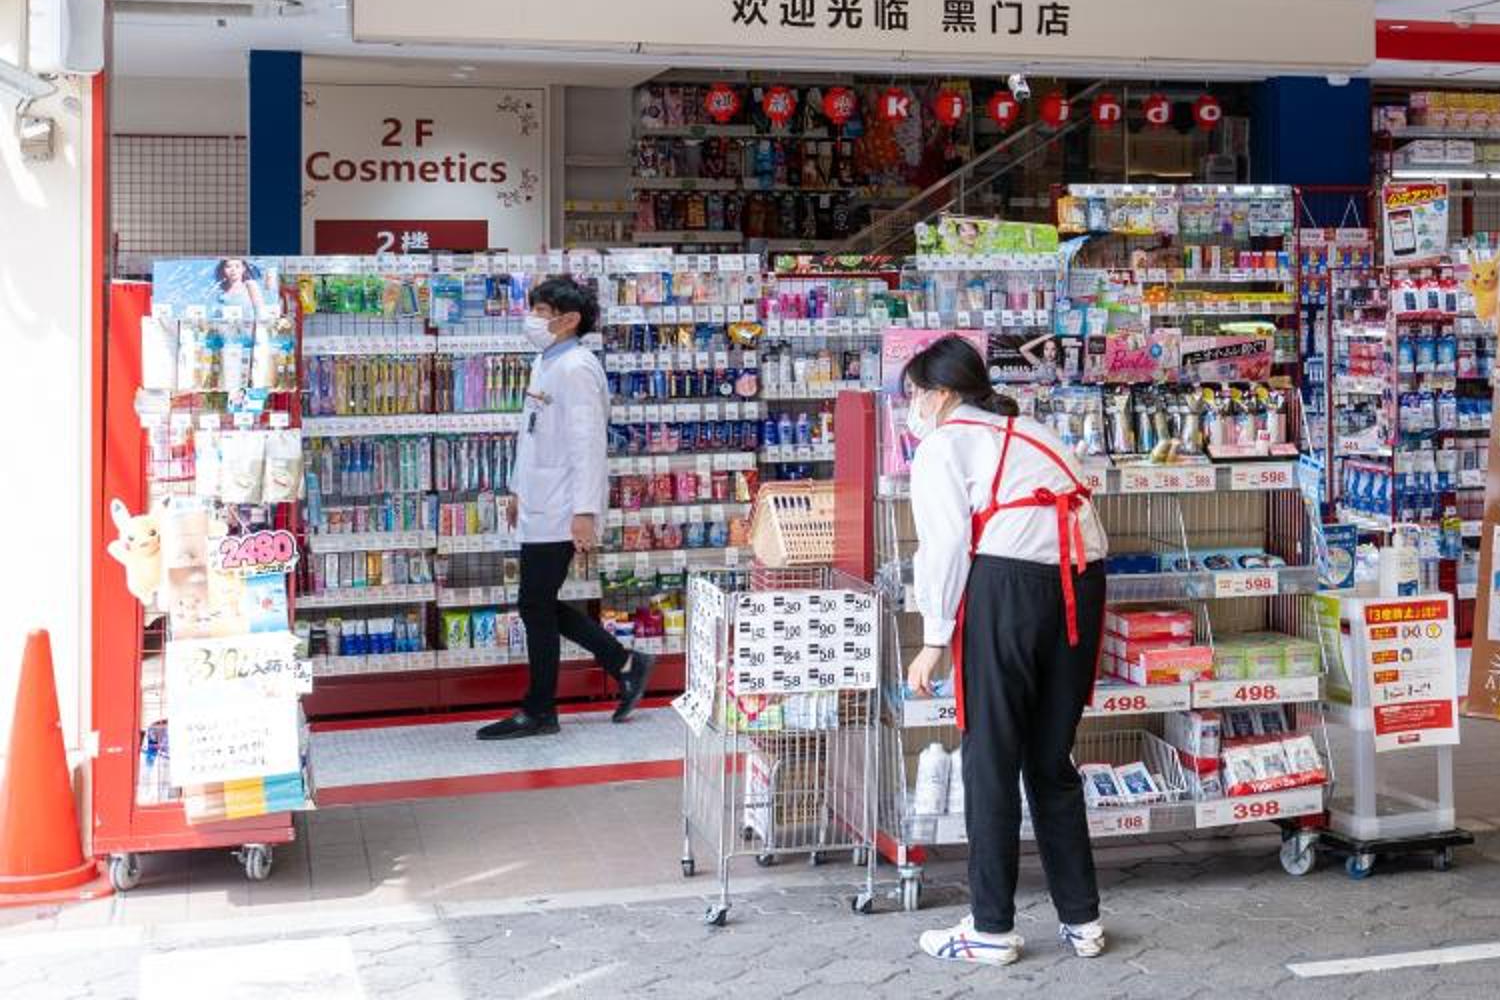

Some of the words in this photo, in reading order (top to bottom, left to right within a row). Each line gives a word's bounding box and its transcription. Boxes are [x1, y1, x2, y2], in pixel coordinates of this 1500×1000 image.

[381, 117, 434, 148] 2F
[305, 152, 507, 184] Cosmetics
[1244, 576, 1272, 591] 598
[1235, 685, 1278, 701] 498
[1104, 696, 1147, 712] 498
[1233, 801, 1280, 819] 398
